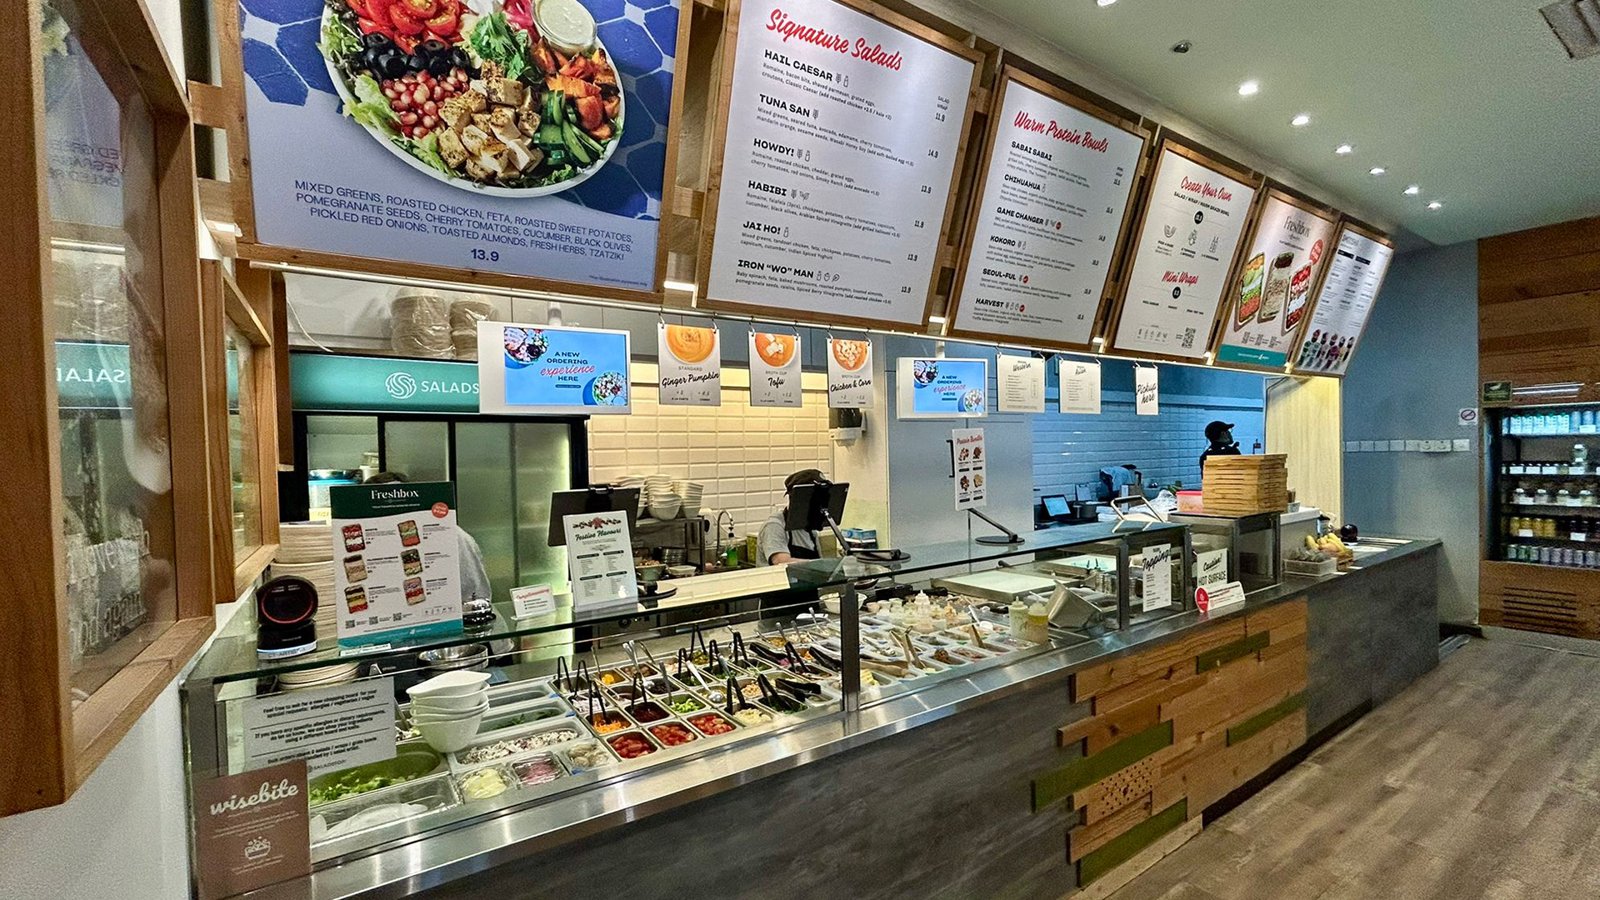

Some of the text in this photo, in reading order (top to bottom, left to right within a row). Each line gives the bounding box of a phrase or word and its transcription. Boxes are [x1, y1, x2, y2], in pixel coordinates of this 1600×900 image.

[766, 8, 903, 71] Signature Salads
[764, 49, 833, 82] HAIL CAESAR
[759, 93, 810, 118] TUNA SAN
[1013, 110, 1109, 153] Warm Protein Bowls
[753, 138, 794, 157] HOWDY!
[1011, 140, 1053, 162] SABAI SABAI
[748, 180, 787, 196] HABIBI
[1004, 173, 1041, 191] CHIHUAHUA
[1180, 175, 1232, 202] Create Your Own
[295, 180, 634, 244] MIXED GREENS, ROASTED CHICKEN, FETA, ROASTED SWEET POTATOES,
[996, 206, 1045, 225] GAME CHANGER
[297, 193, 633, 254] POMEGRANATE SEEDS, CHERRY TOMATOES, CUCUMBER, BLACK OLIVES,
[310, 207, 359, 223] PICKLED
[361, 215, 384, 227] RED
[386, 219, 430, 234] ONIONS,
[432, 225, 479, 240] TOASTED
[481, 234, 529, 248] ALMONDS,
[530, 240, 557, 251] FRESH
[558, 245, 587, 256] HERBS,
[742, 221, 782, 235] JAI HO!
[990, 235, 1016, 247] KOKORO
[471, 249, 499, 262] 13.9
[738, 259, 764, 271] IRON
[793, 269, 814, 279] MAN
[982, 268, 1017, 281] SEOUL-FUL
[975, 297, 1005, 308] HARVEST
[546, 357, 589, 365] ORDERING
[540, 363, 596, 378] experience
[661, 371, 720, 389] Ginger Pumpkin
[767, 377, 786, 389] Tofu
[830, 383, 853, 393] Chicken
[857, 378, 872, 388] Corn
[933, 384, 967, 394] experience
[371, 489, 420, 500] Freshbox
[574, 528, 622, 542] Festive Flavours
[1208, 570, 1227, 584] SURFACE
[210, 778, 299, 816] wisebite
